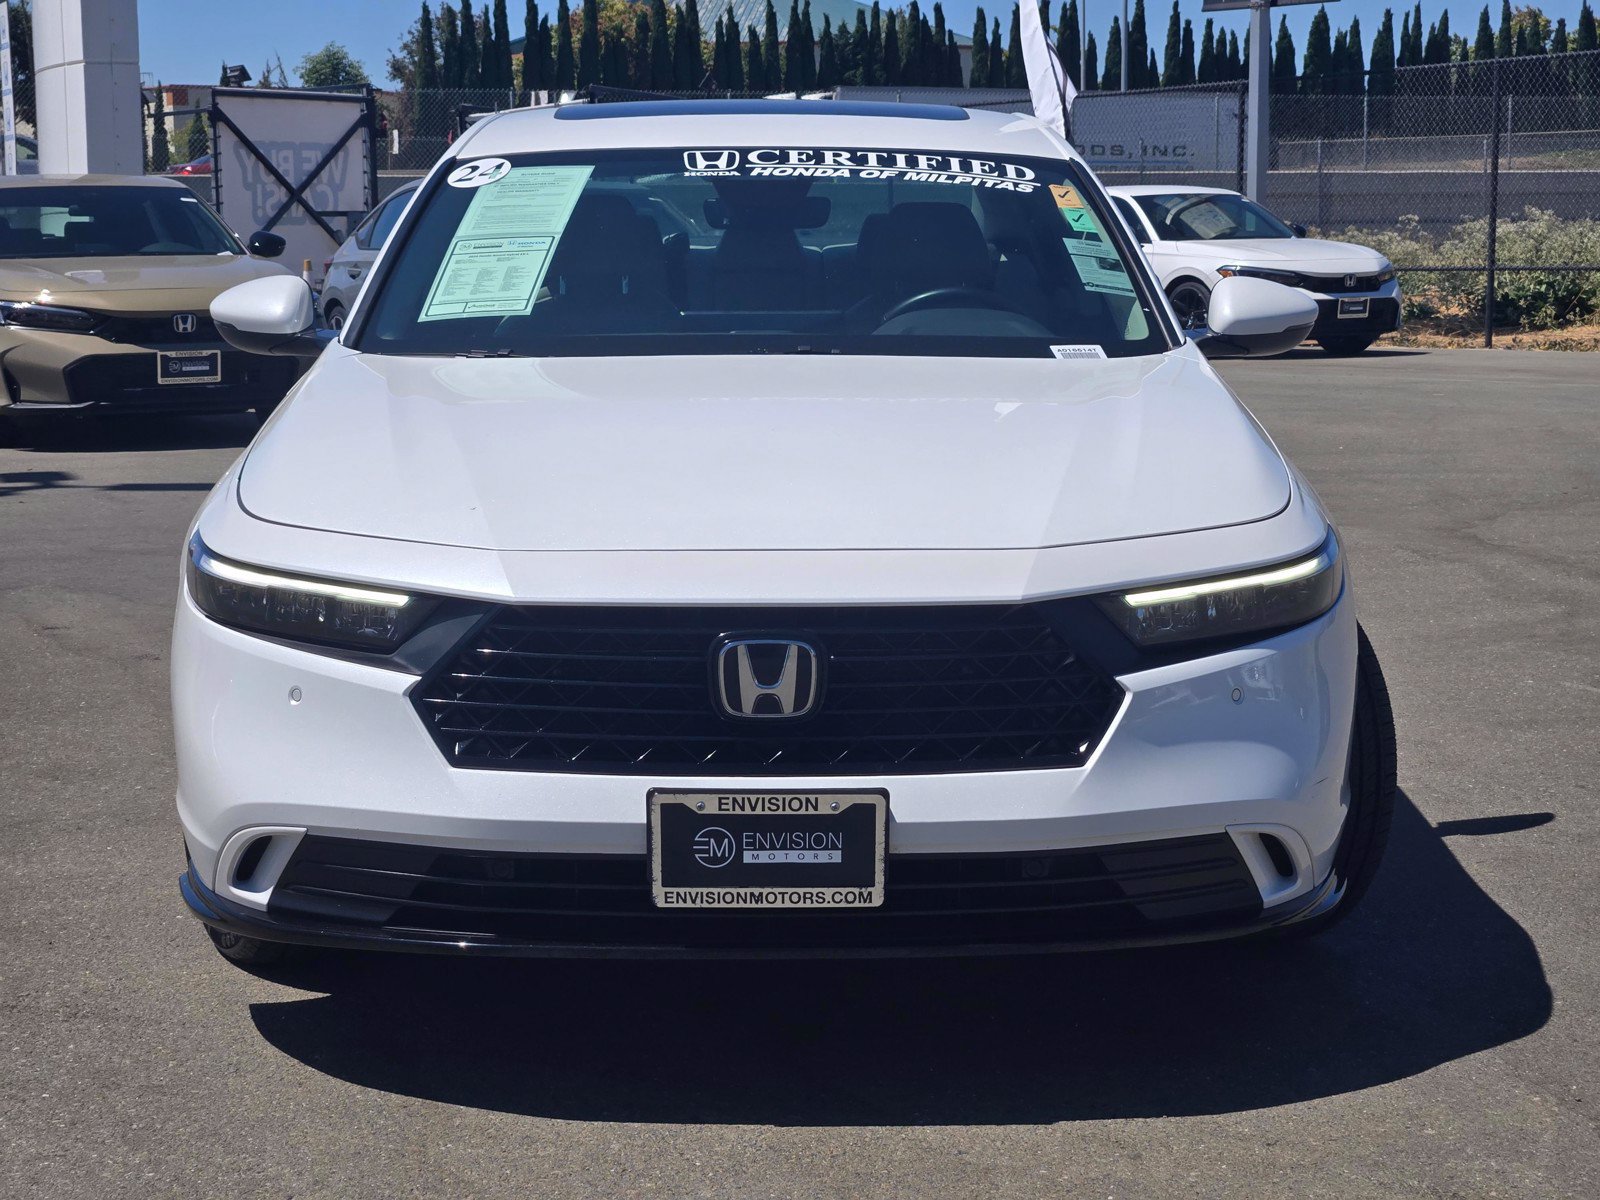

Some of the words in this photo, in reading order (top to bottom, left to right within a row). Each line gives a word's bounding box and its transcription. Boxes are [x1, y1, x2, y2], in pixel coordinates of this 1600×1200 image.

[1141, 145, 1194, 157] INC.
[452, 162, 505, 183] 24
[747, 149, 1036, 181] CERTIFIED
[750, 167, 850, 178] HONDA
[859, 169, 899, 179] OF
[903, 171, 1034, 193] MILPITAS
[717, 796, 819, 812] ENVISION
[743, 832, 842, 849] ENVISION
[751, 853, 834, 861] MOTORS
[664, 891, 873, 905] ENVISIONMOTORS.COM
